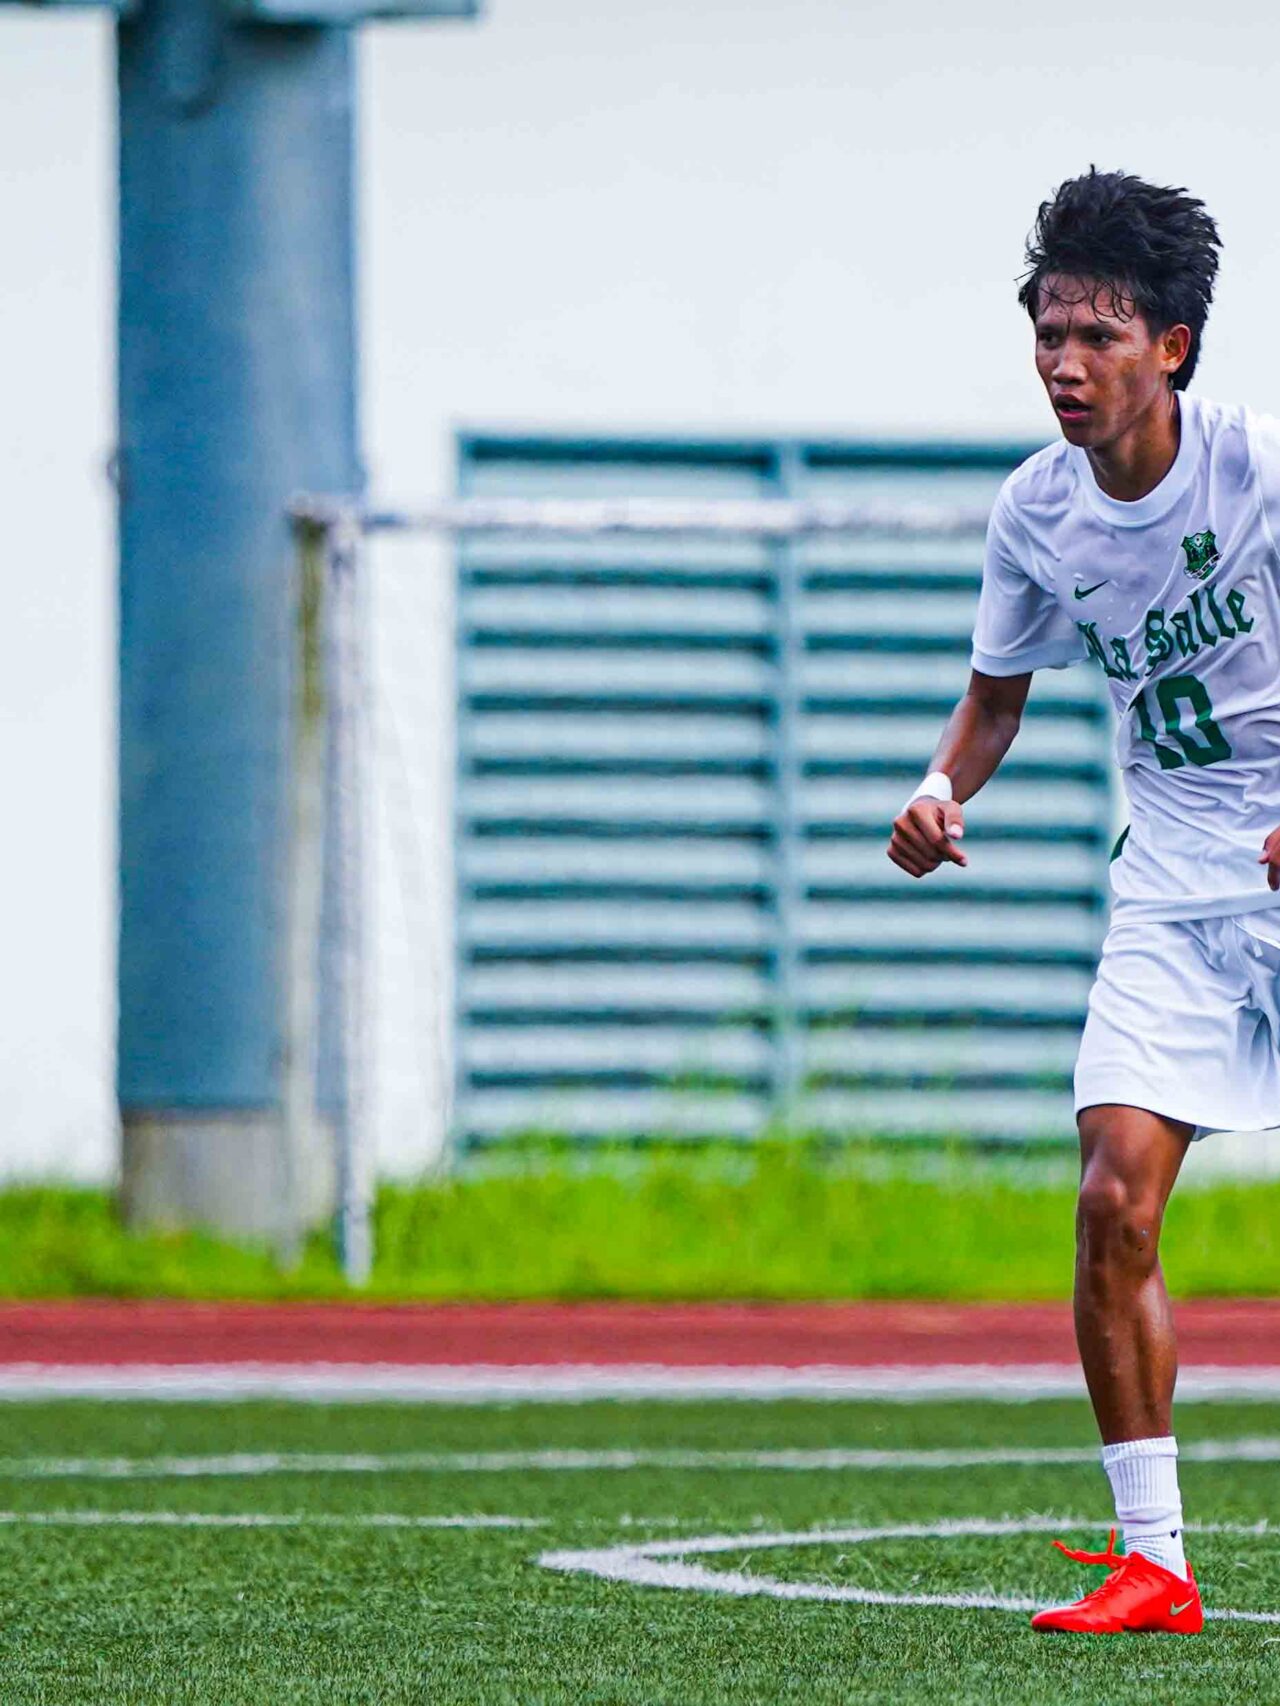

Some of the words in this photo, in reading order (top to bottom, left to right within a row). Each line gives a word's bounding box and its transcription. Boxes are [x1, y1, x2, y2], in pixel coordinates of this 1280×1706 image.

[1077, 621, 1138, 681] La
[1144, 584, 1254, 675] Salle
[1128, 674, 1232, 769] 10
